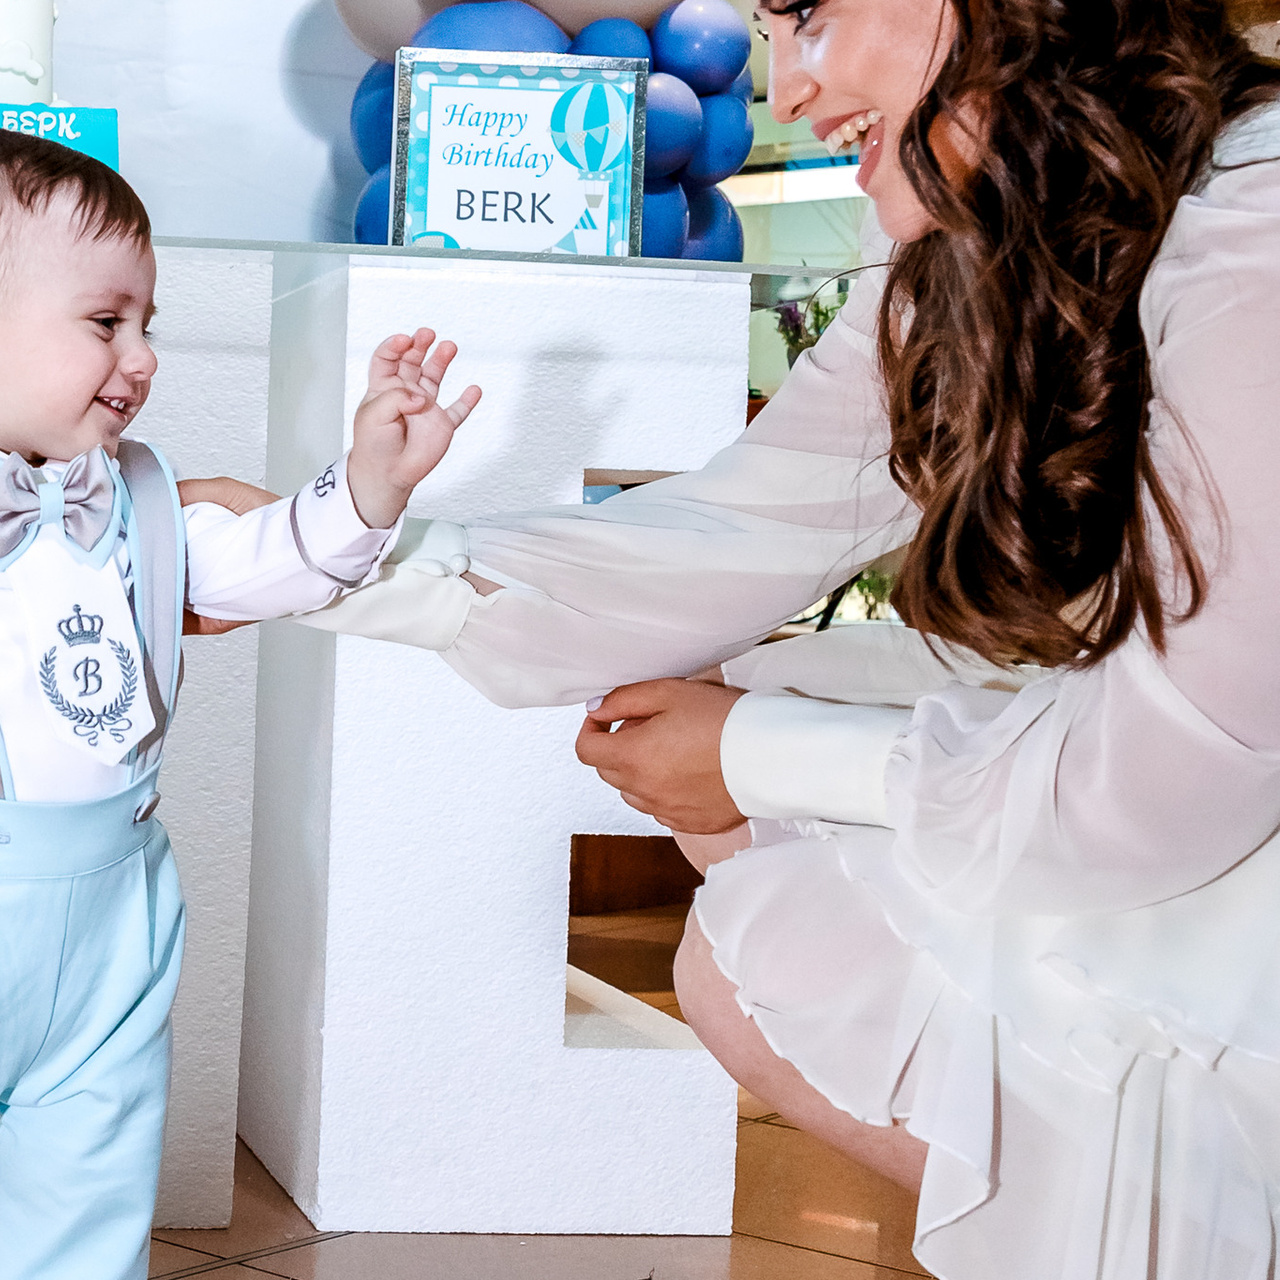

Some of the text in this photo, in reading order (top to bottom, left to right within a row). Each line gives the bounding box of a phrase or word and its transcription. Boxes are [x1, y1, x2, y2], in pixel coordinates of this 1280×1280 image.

[442, 103, 528, 138] Happy
[442, 142, 554, 178] Birthday
[456, 189, 554, 224] BERK
[73, 656, 103, 698] B
